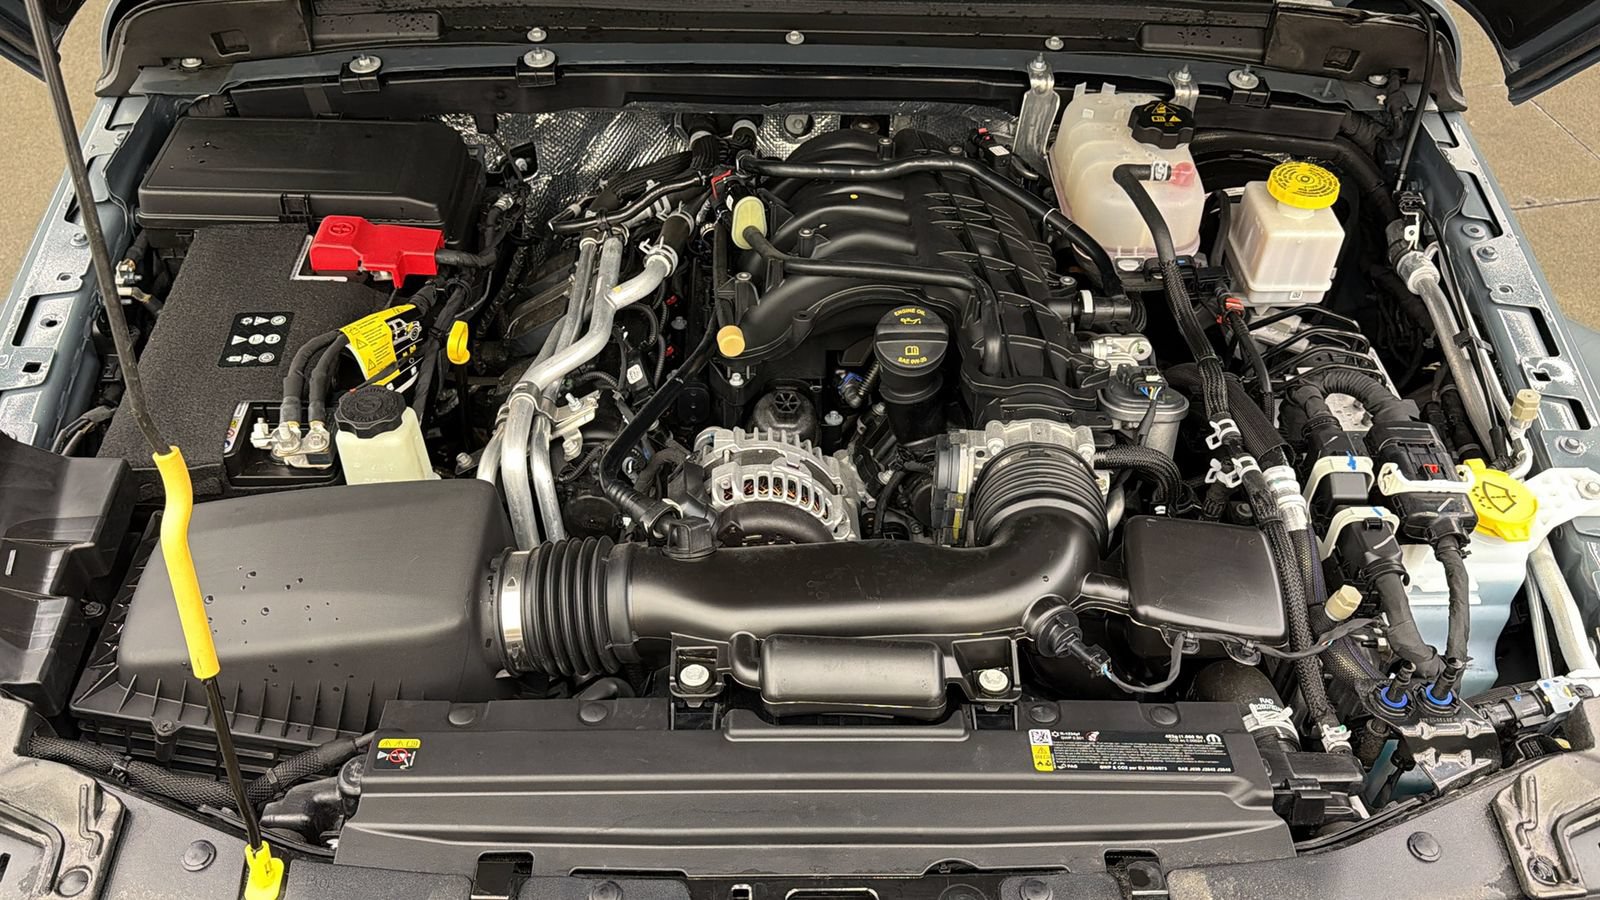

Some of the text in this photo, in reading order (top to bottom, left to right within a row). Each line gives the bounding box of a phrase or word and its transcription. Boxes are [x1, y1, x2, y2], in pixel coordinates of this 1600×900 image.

[894, 308, 915, 317] ENGINE
[897, 356, 910, 364] SAE
[1259, 697, 1274, 705] RAD
